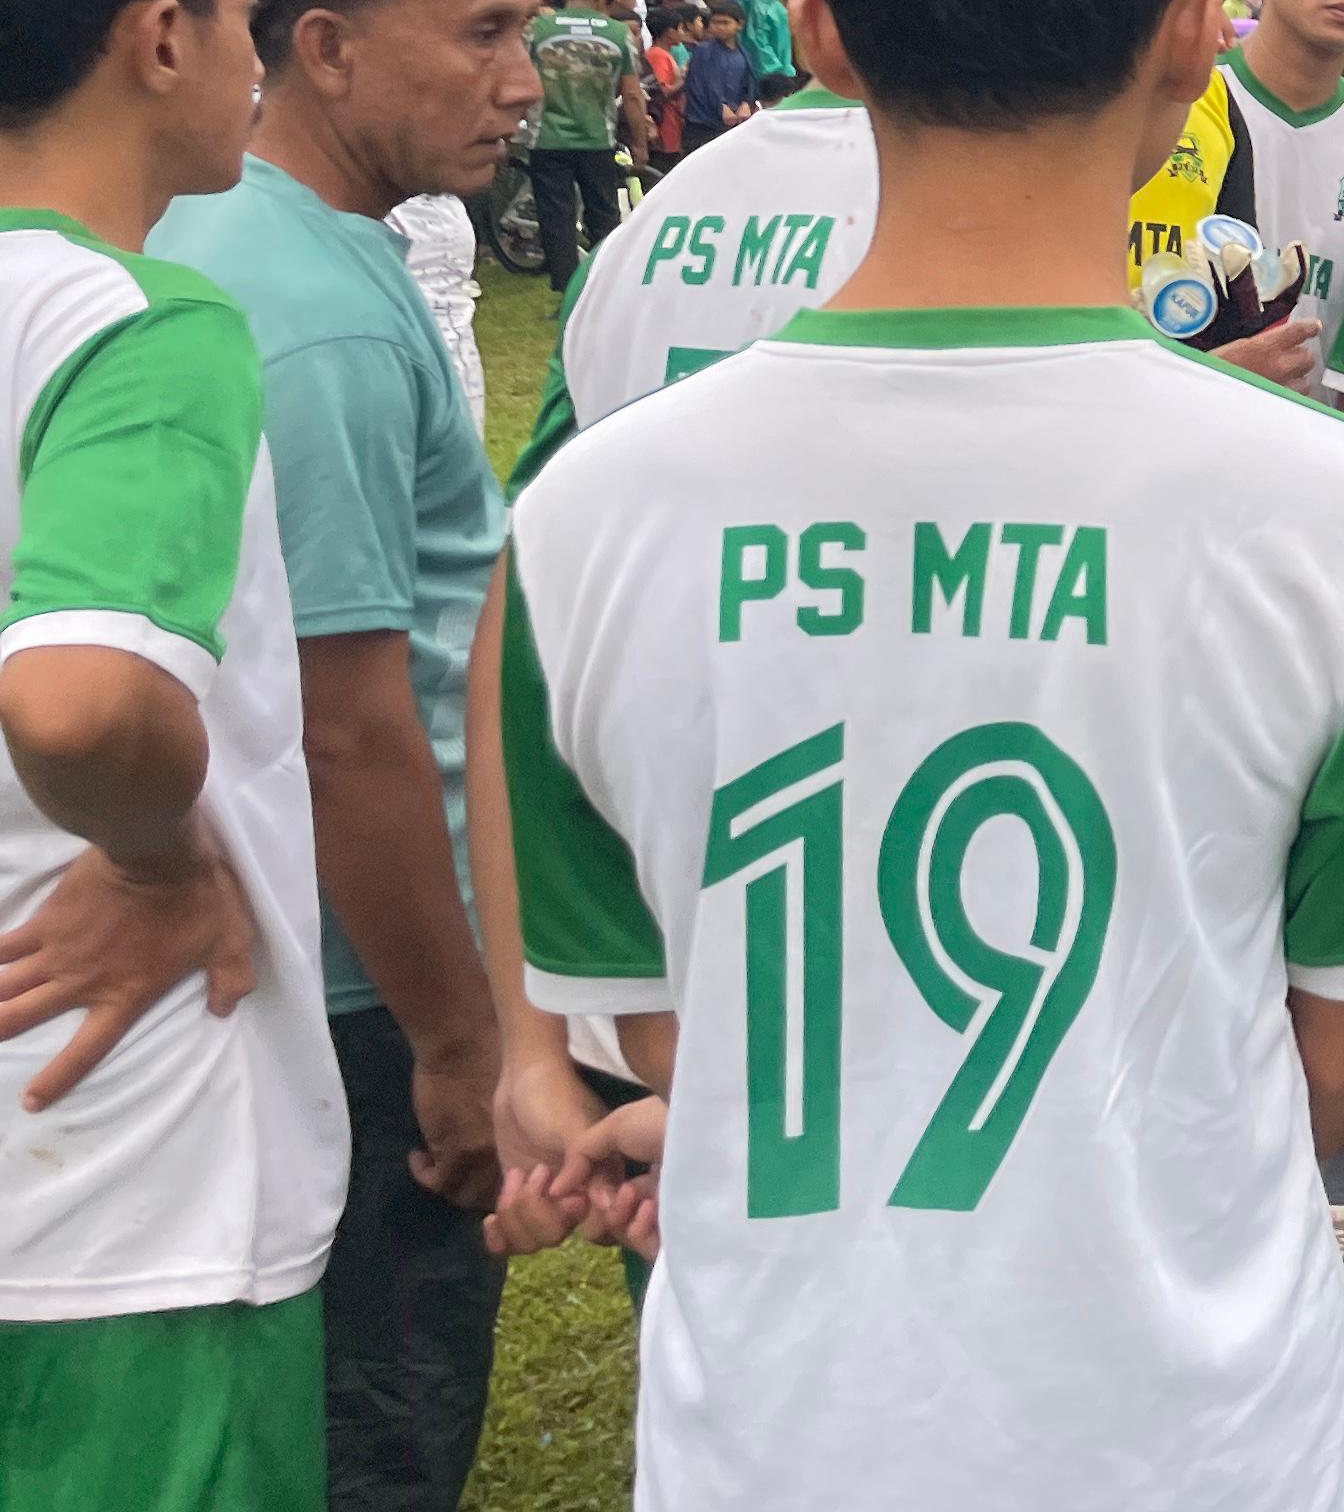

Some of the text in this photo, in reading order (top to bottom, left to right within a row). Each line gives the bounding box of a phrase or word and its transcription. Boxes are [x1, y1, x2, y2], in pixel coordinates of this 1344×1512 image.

[641, 214, 837, 290] PS MTA
[1305, 253, 1334, 300] TA
[718, 522, 1109, 646] PS MTA
[700, 721, 1118, 1220] 19
